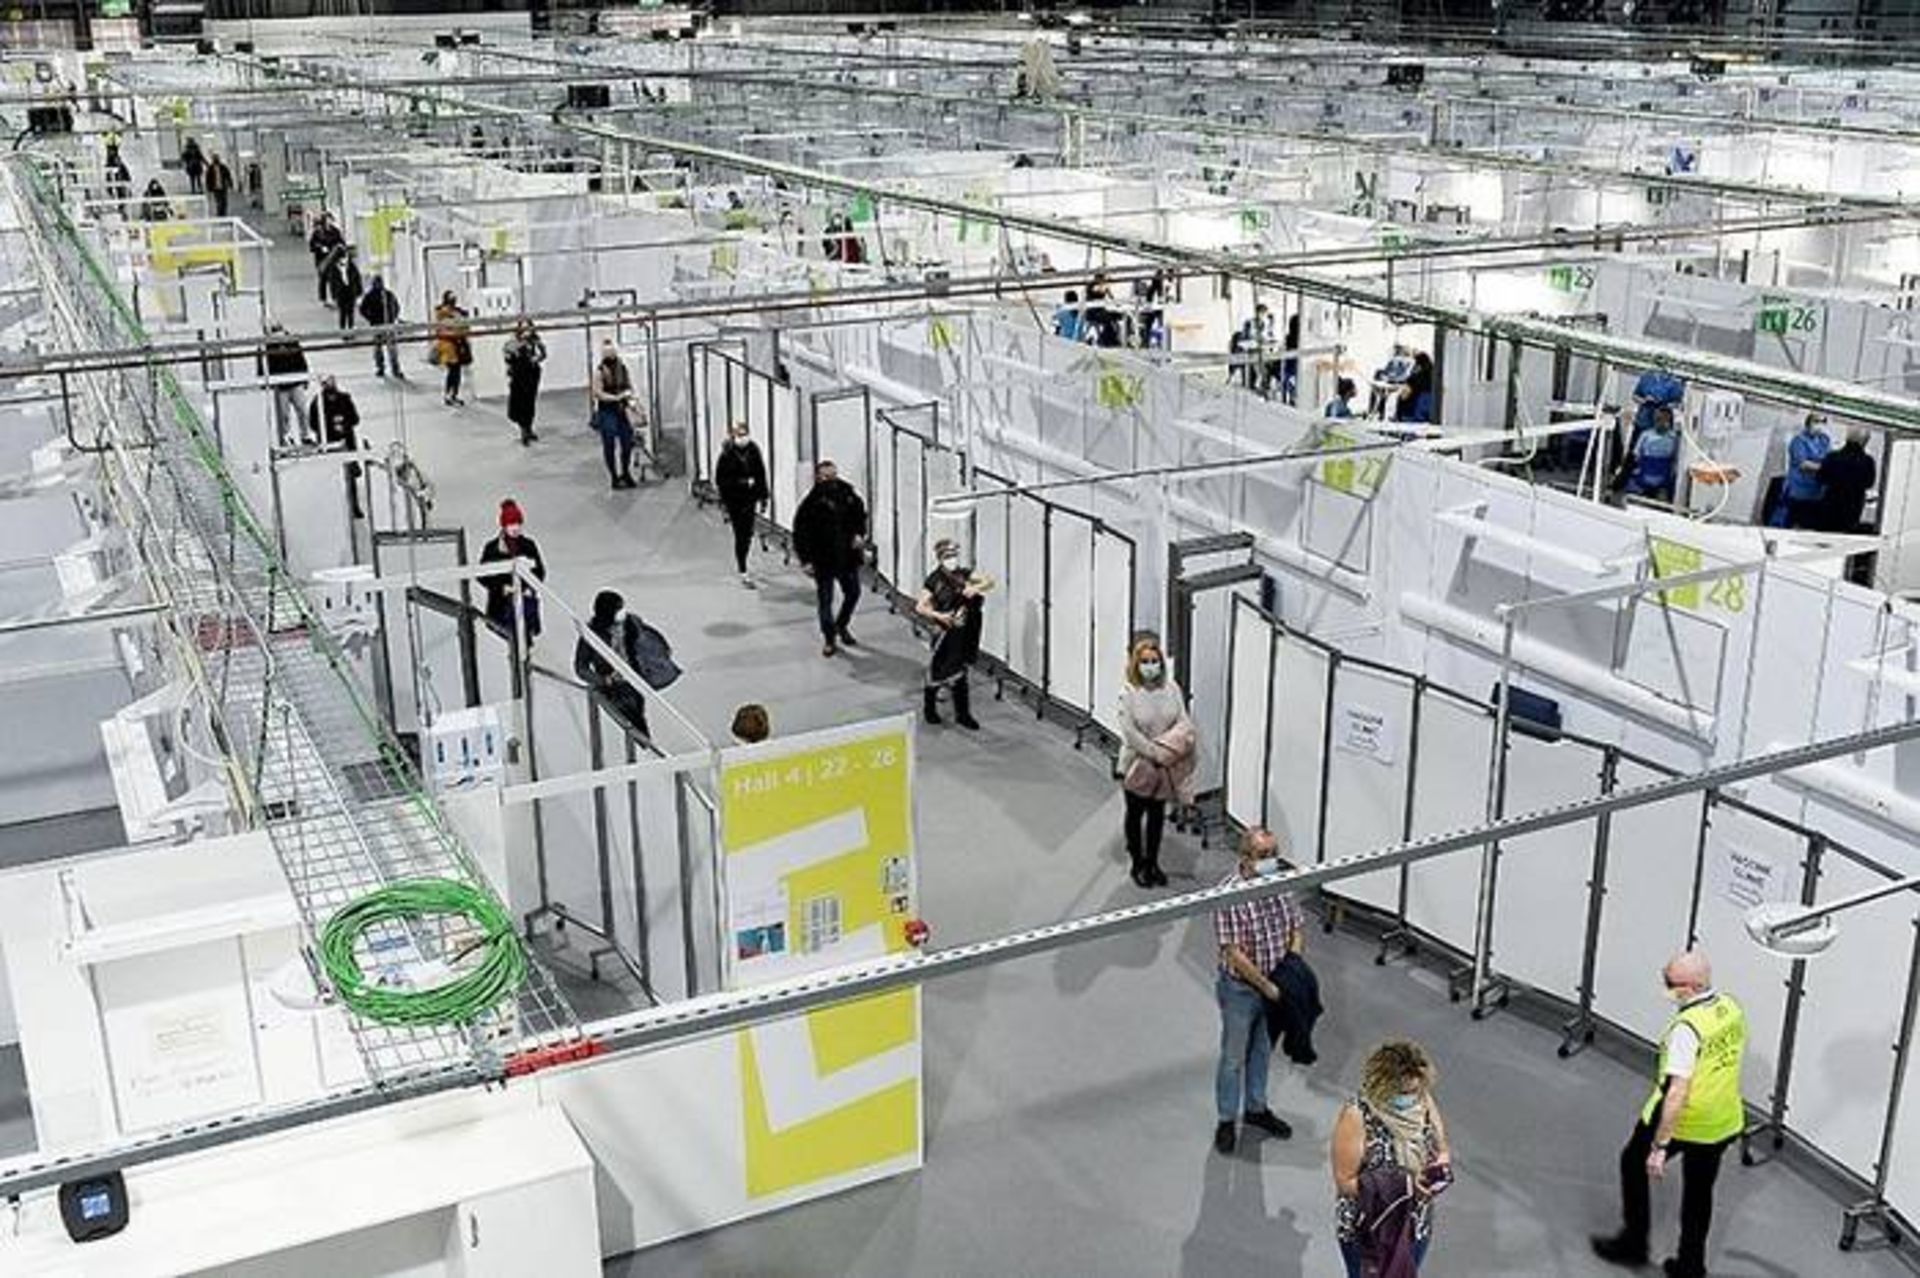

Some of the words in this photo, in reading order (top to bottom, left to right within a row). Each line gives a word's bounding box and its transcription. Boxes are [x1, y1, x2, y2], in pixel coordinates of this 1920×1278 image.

[1574, 266, 1595, 289] 25
[1792, 306, 1817, 332] 26
[1707, 571, 1745, 613] 28
[735, 768, 778, 796] Hall
[785, 766, 802, 785] 4
[818, 755, 848, 780] 22
[869, 746, 897, 769] 26
